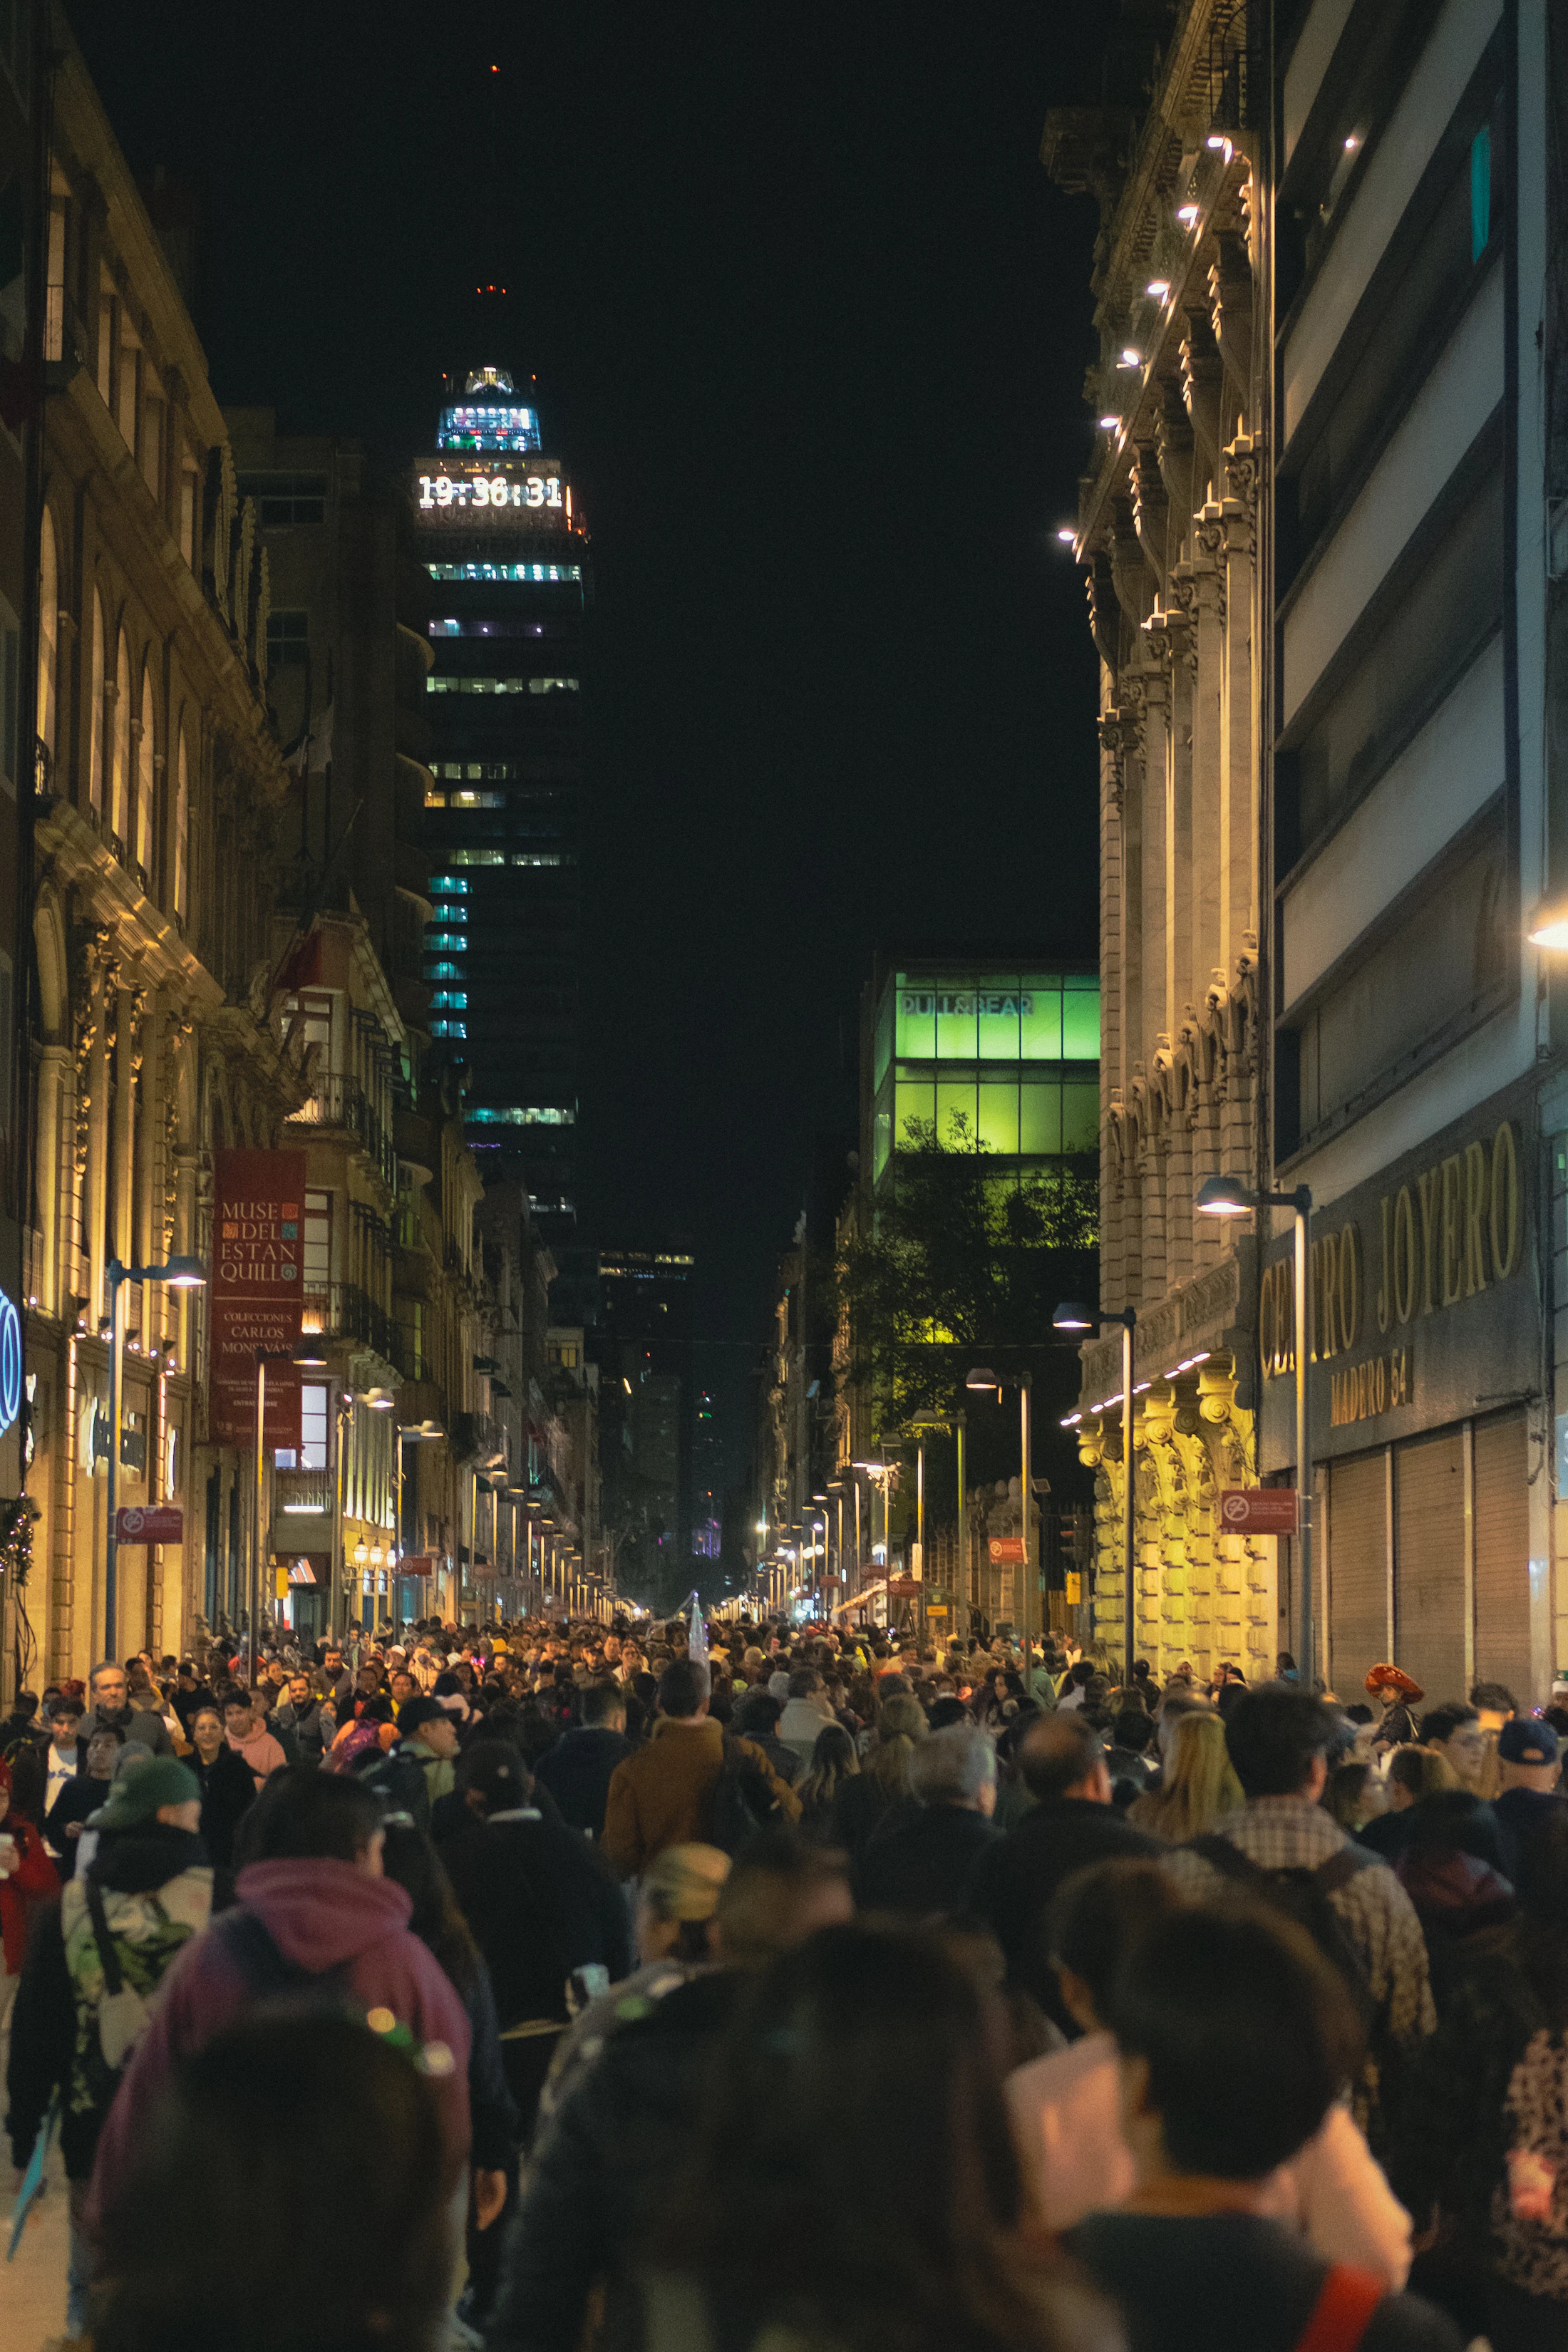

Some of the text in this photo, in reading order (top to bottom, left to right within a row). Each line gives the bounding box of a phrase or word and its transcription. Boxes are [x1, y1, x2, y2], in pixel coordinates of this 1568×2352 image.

[419, 475, 562, 507] 19:36:31
[242, 1222, 280, 1239] DEL
[1378, 1121, 1517, 1333] JOYERO
[222, 1242, 295, 1260] ESTAN
[231, 1326, 284, 1339] CARLOS
[1330, 1356, 1385, 1427] MADERO
